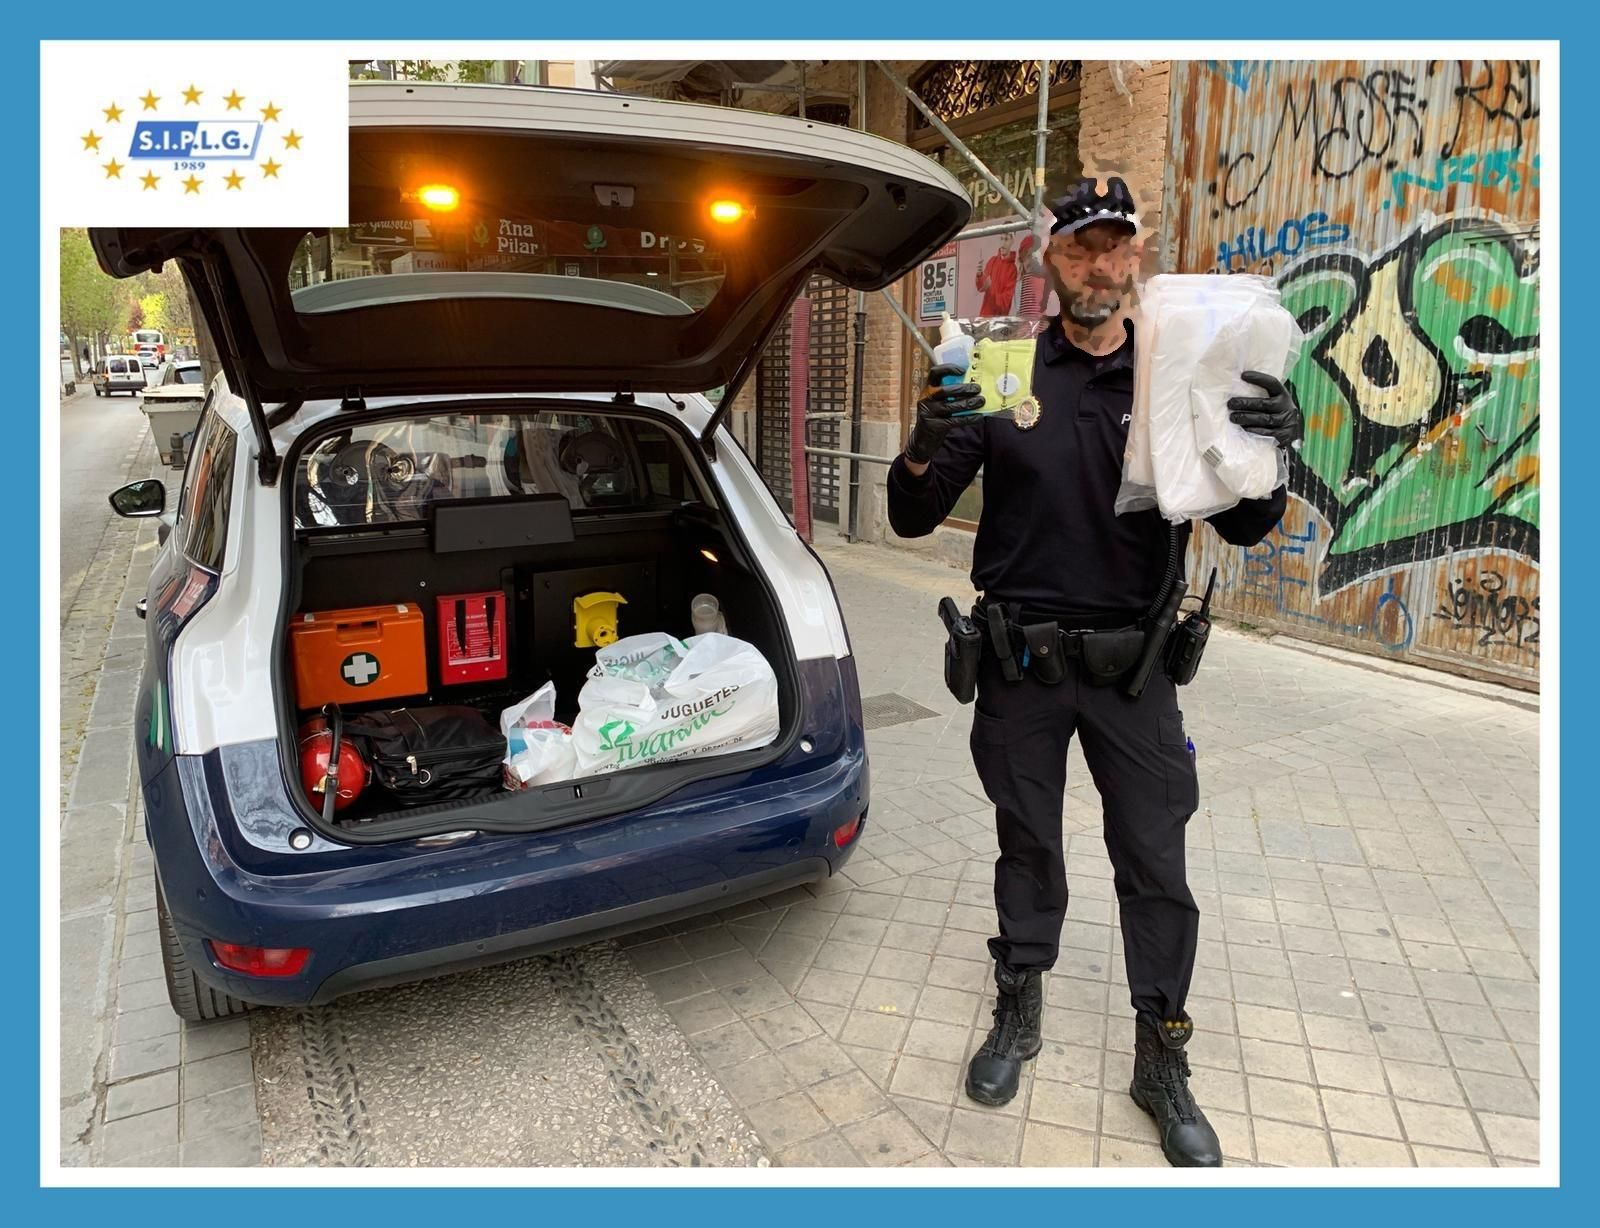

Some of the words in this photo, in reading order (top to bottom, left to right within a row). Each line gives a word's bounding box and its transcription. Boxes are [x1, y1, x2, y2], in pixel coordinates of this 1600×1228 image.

[499, 218, 534, 237] Ana
[497, 236, 538, 254] Pilar
[661, 685, 741, 720] JUGUETES
